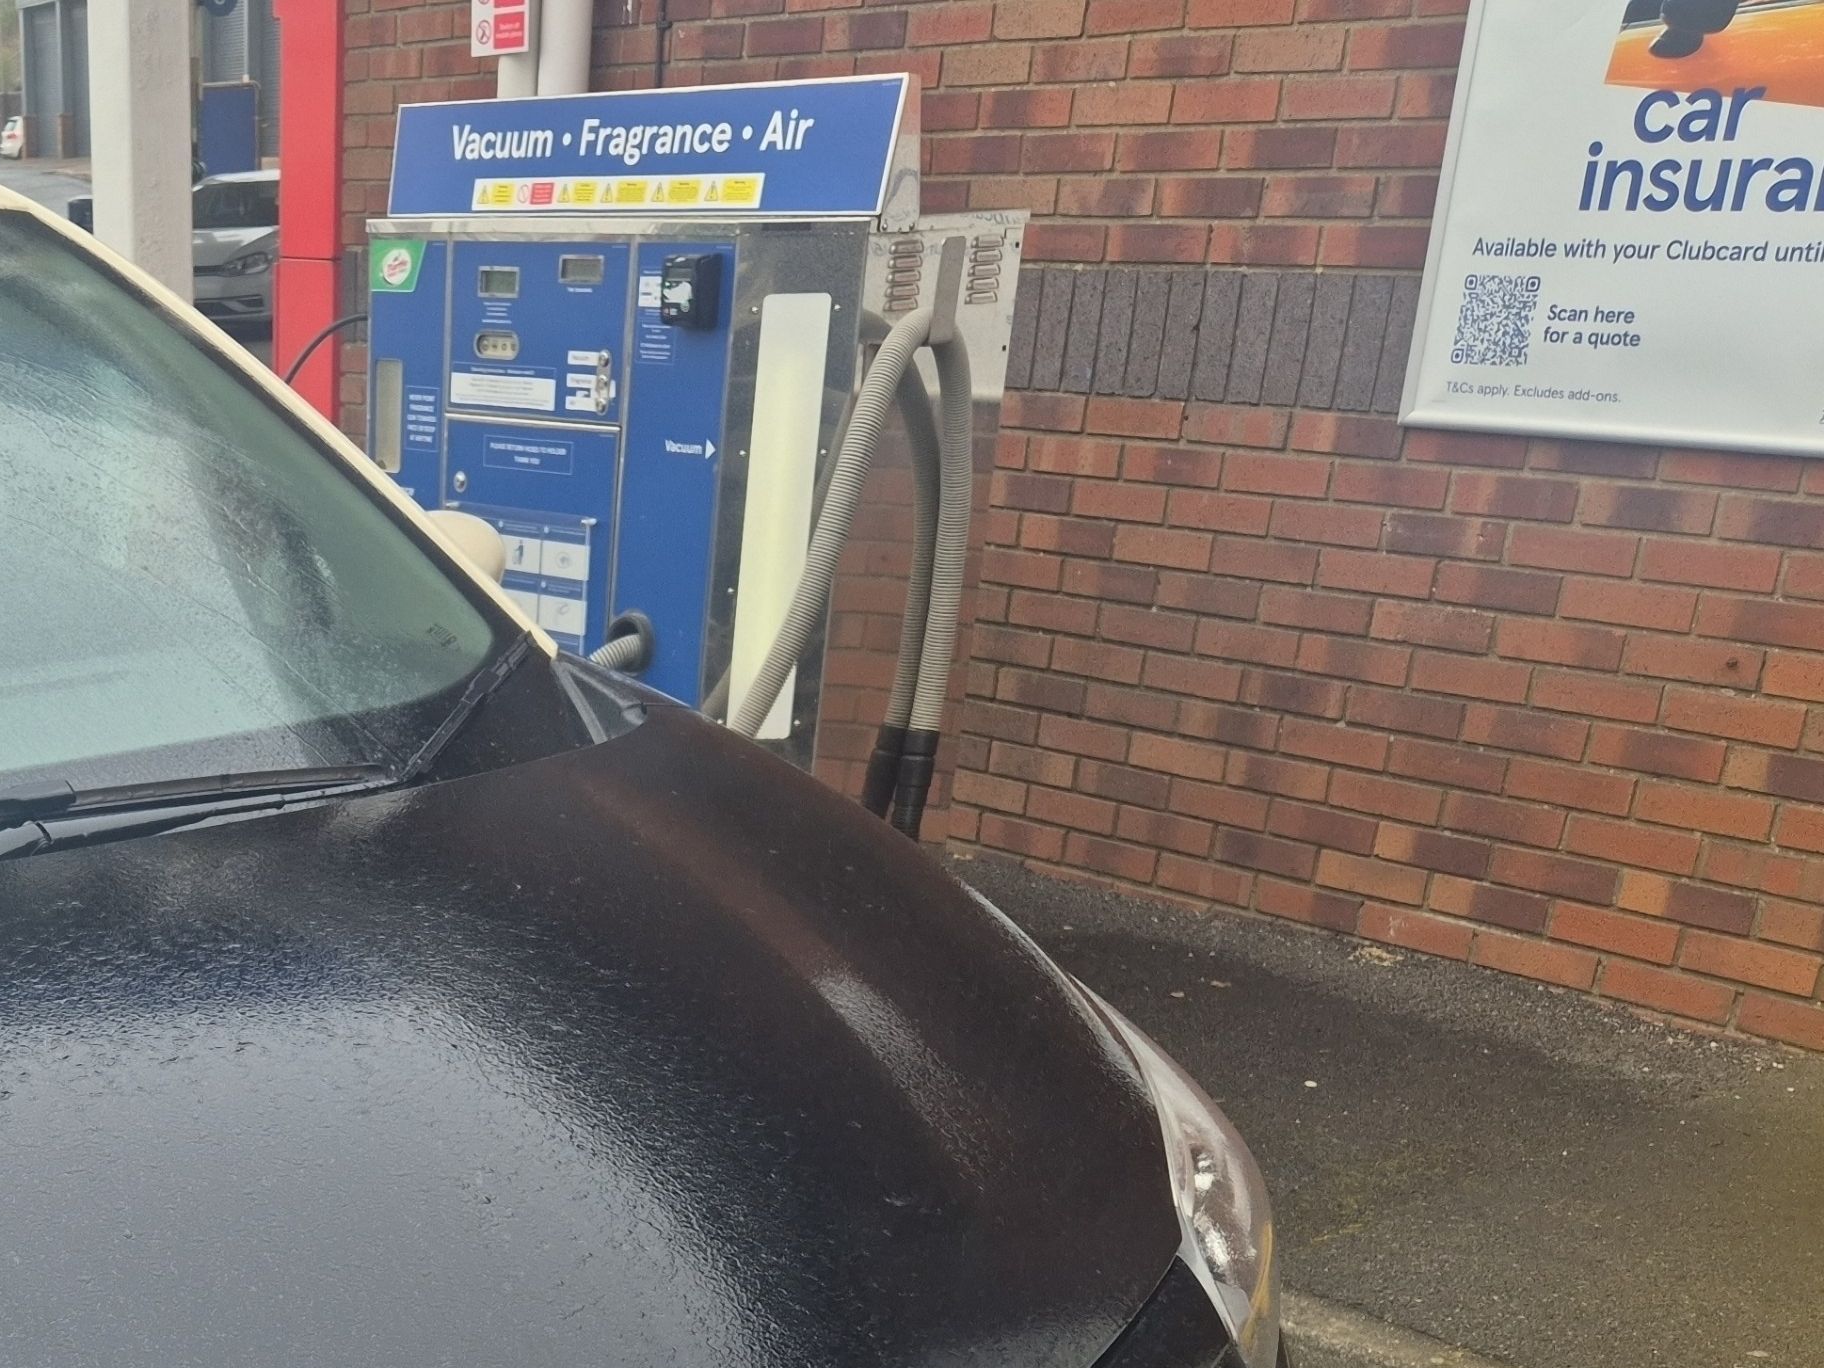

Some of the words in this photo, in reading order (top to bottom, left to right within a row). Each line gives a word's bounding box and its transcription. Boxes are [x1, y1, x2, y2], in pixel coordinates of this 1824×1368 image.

[1633, 86, 1767, 143] car
[452, 124, 554, 161] Vacuum
[579, 118, 733, 166] Fragrance
[759, 108, 815, 151] Air
[1578, 141, 1824, 213] insura
[1472, 237, 1557, 258] Available
[1564, 239, 1606, 259] with
[1613, 242, 1661, 264] your
[1666, 240, 1768, 262] Clubcard
[1547, 304, 1588, 322] Scan
[1593, 305, 1635, 324] here
[1543, 326, 1569, 343] for
[1572, 331, 1583, 344] a
[1588, 331, 1641, 349] quote
[1446, 381, 1474, 394] T&Cs
[1477, 384, 1510, 397] apply.
[1514, 384, 1564, 400] Excludes
[1567, 389, 1622, 404] add-ons.
[664, 439, 703, 455] Vacuum
